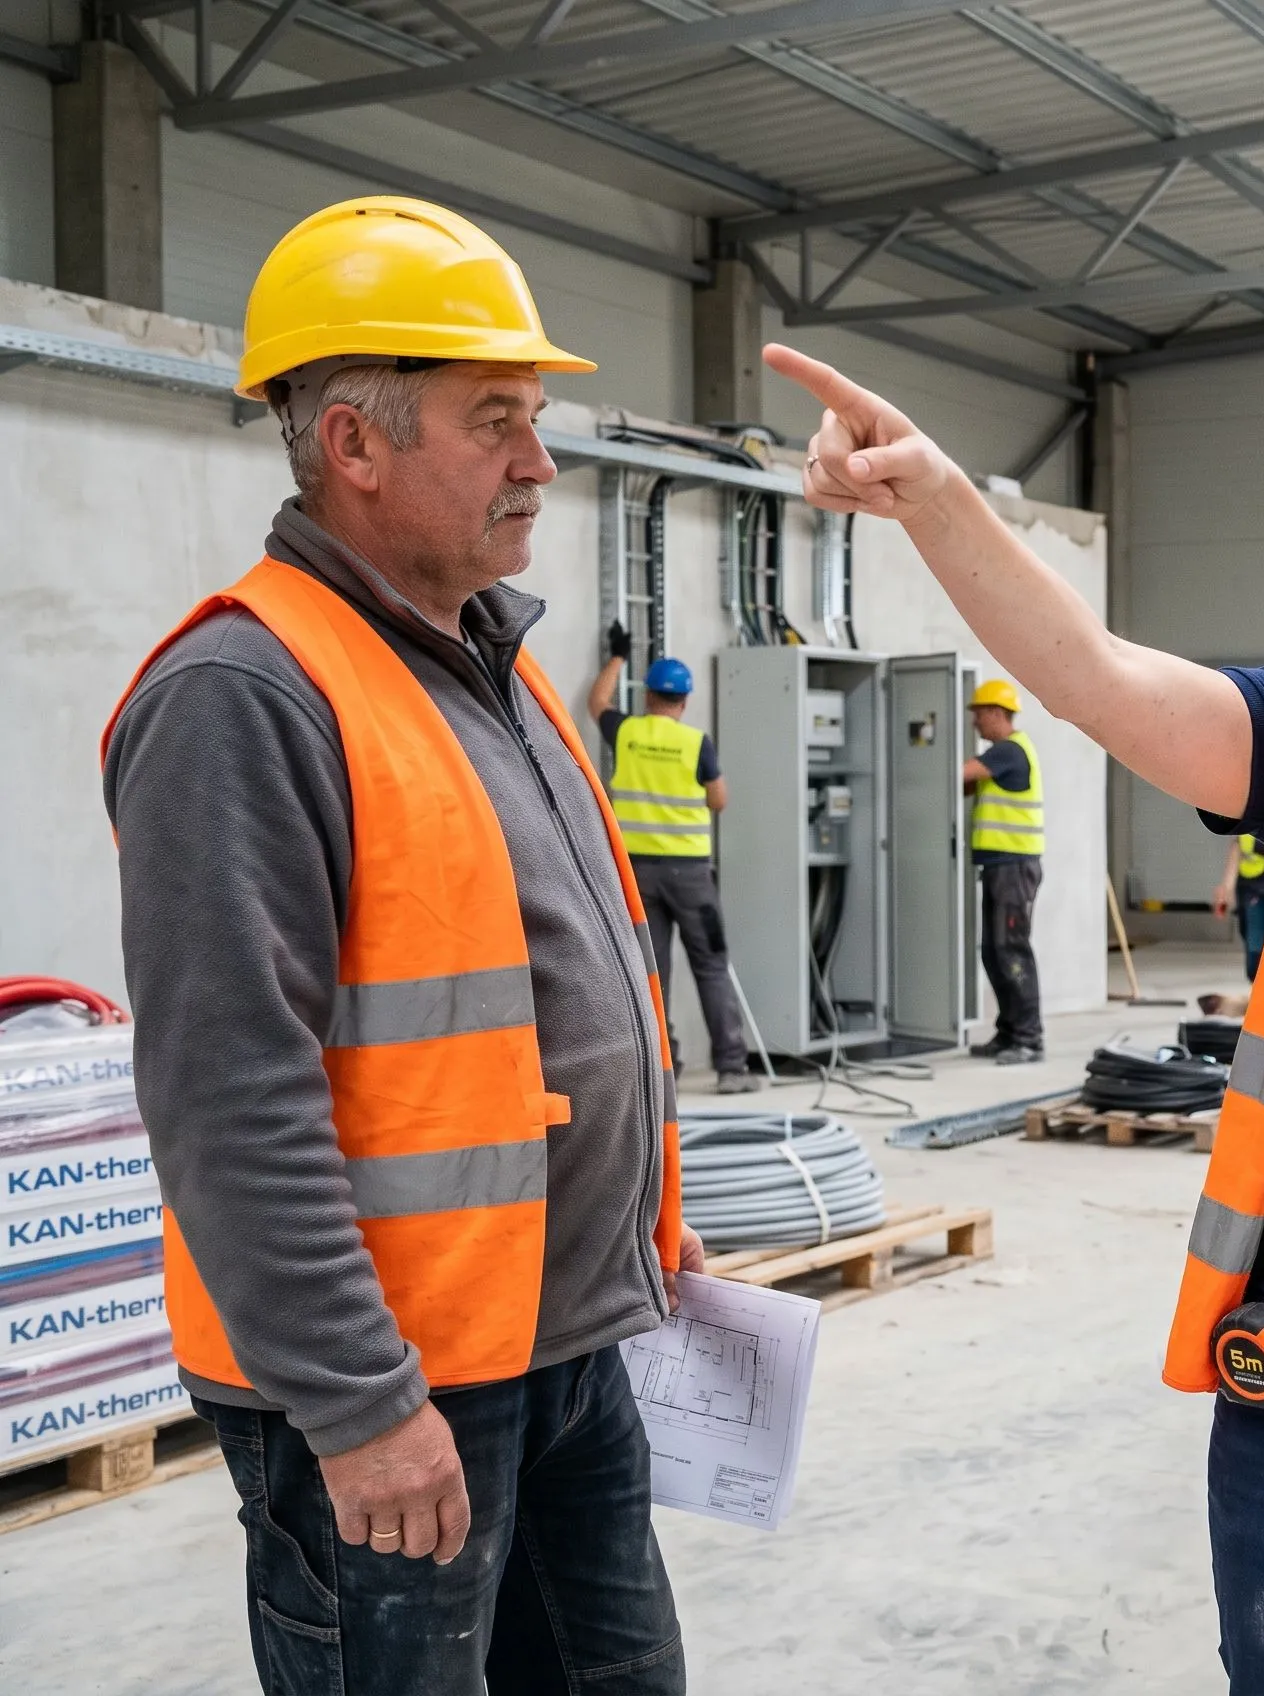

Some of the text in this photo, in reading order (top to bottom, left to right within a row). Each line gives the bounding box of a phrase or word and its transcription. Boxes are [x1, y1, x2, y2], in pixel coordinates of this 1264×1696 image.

[9, 1205, 163, 1247] KAN-ther
[10, 1296, 165, 1344] KAN-ther
[1230, 1349, 1263, 1372] 5m
[11, 1383, 183, 1443] KAN-therm
